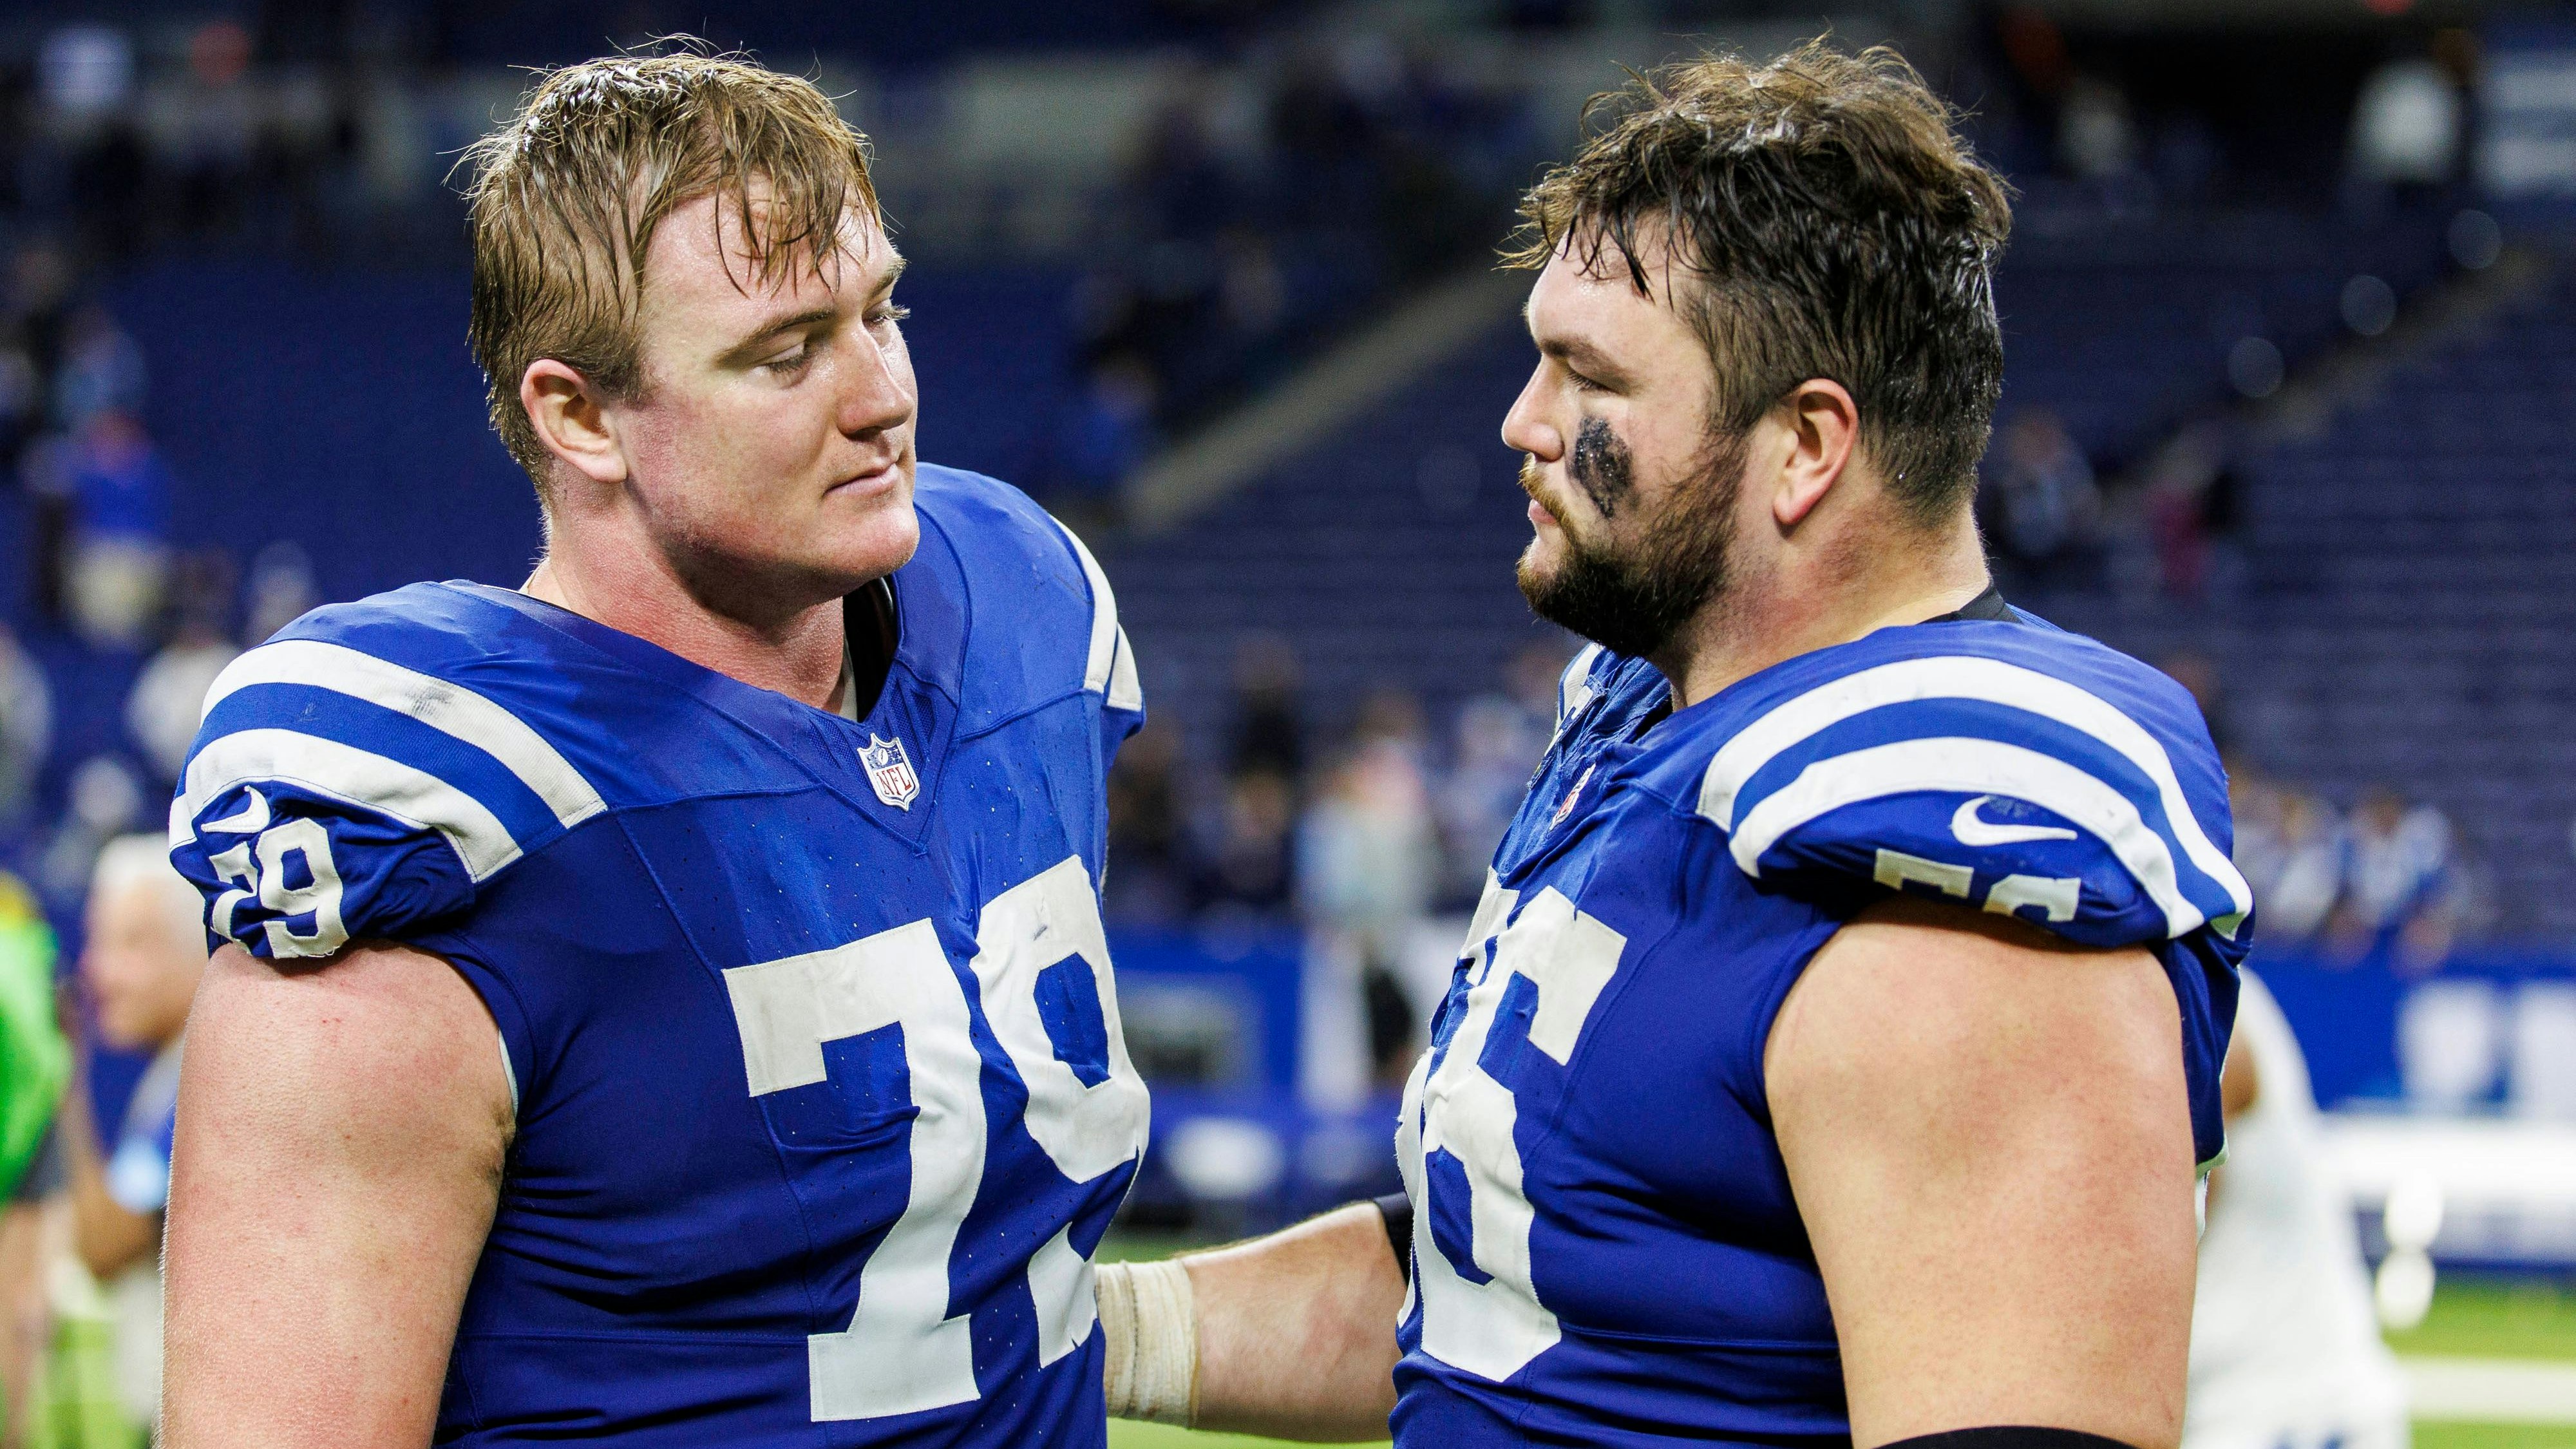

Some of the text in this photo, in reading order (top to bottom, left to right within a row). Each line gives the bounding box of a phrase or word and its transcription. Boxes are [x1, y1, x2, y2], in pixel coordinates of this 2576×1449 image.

[876, 766, 912, 795] NFL
[209, 817, 350, 959] 79
[722, 854, 1151, 1422] 79
